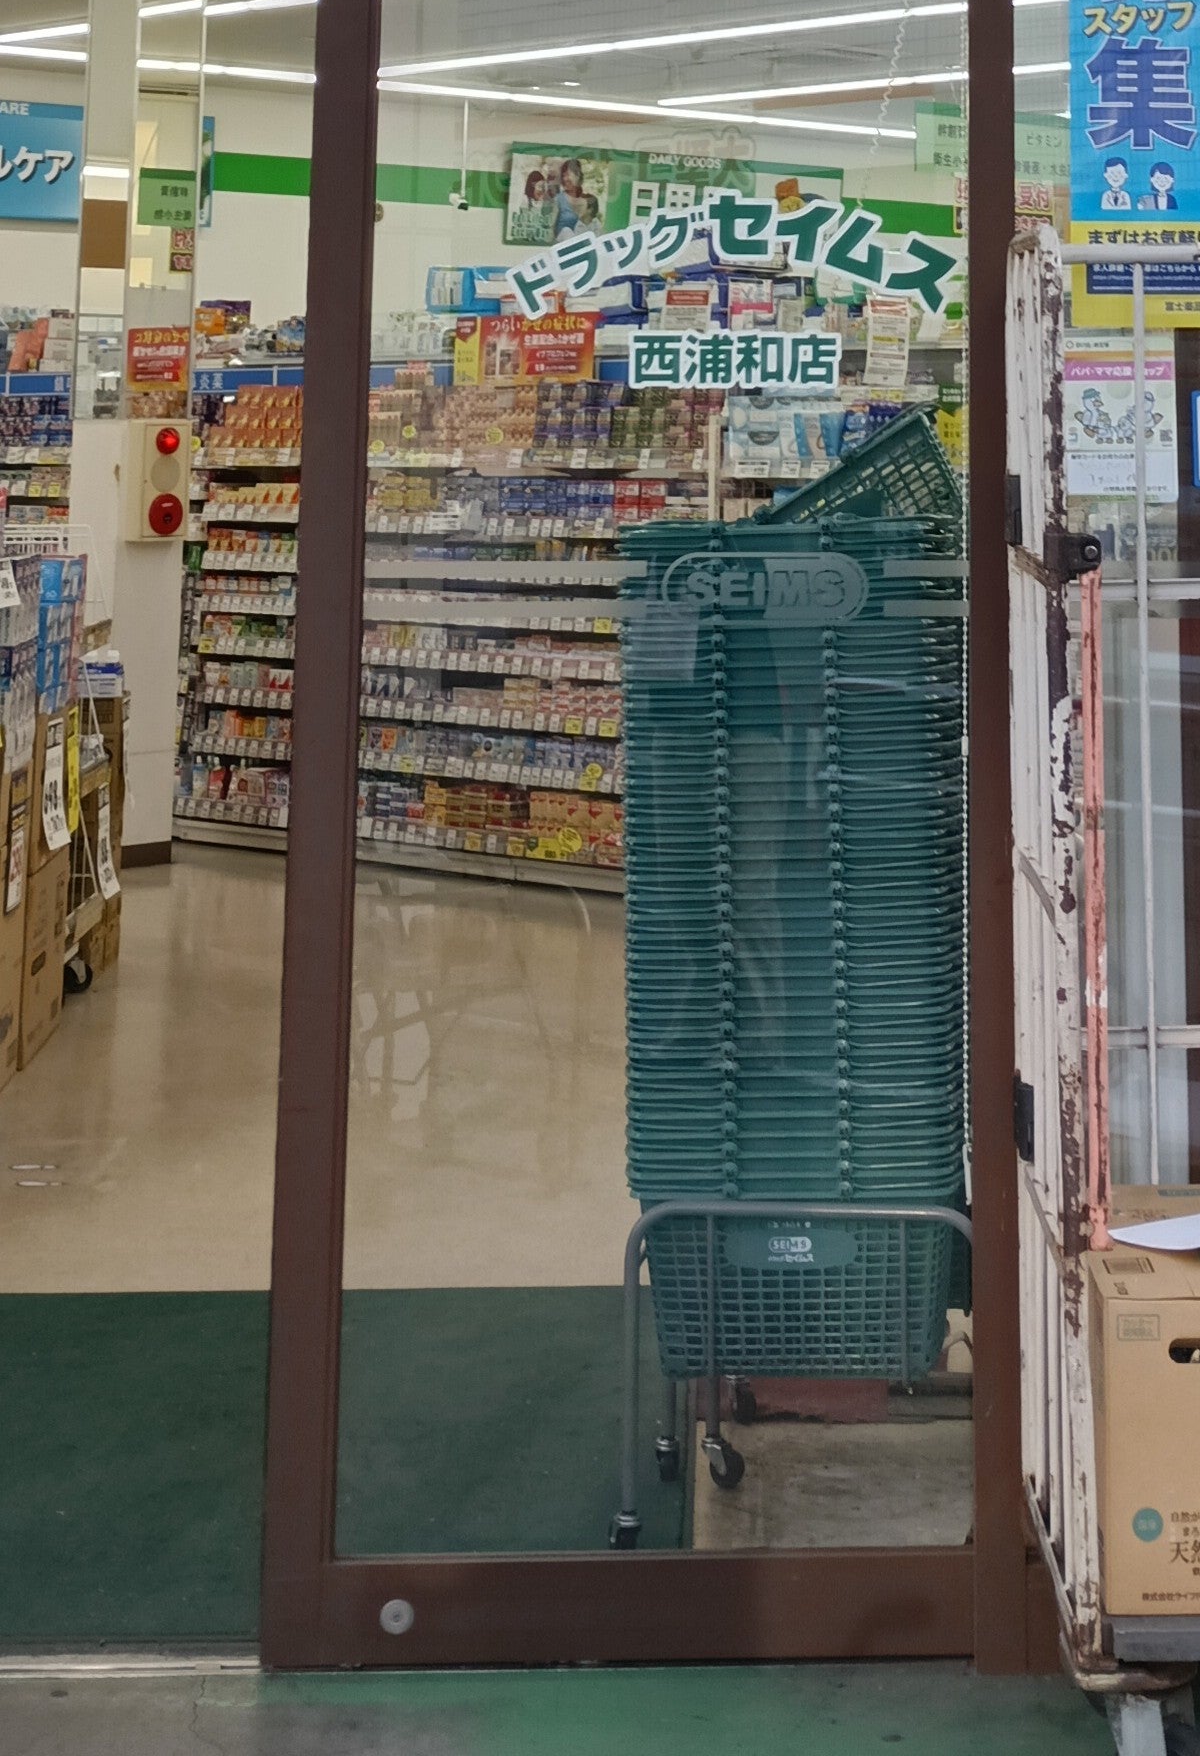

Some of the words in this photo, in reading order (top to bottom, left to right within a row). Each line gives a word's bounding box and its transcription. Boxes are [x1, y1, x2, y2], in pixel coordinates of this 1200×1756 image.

[1084, 1, 1195, 36] スタッフ
[1026, 133, 1063, 148] ビタミン
[649, 152, 681, 166] DAILY
[683, 155, 722, 170] GOODS
[632, 334, 838, 384] 西浦和店
[685, 568, 846, 608] SEIMS
[772, 1239, 807, 1251] SEIMS
